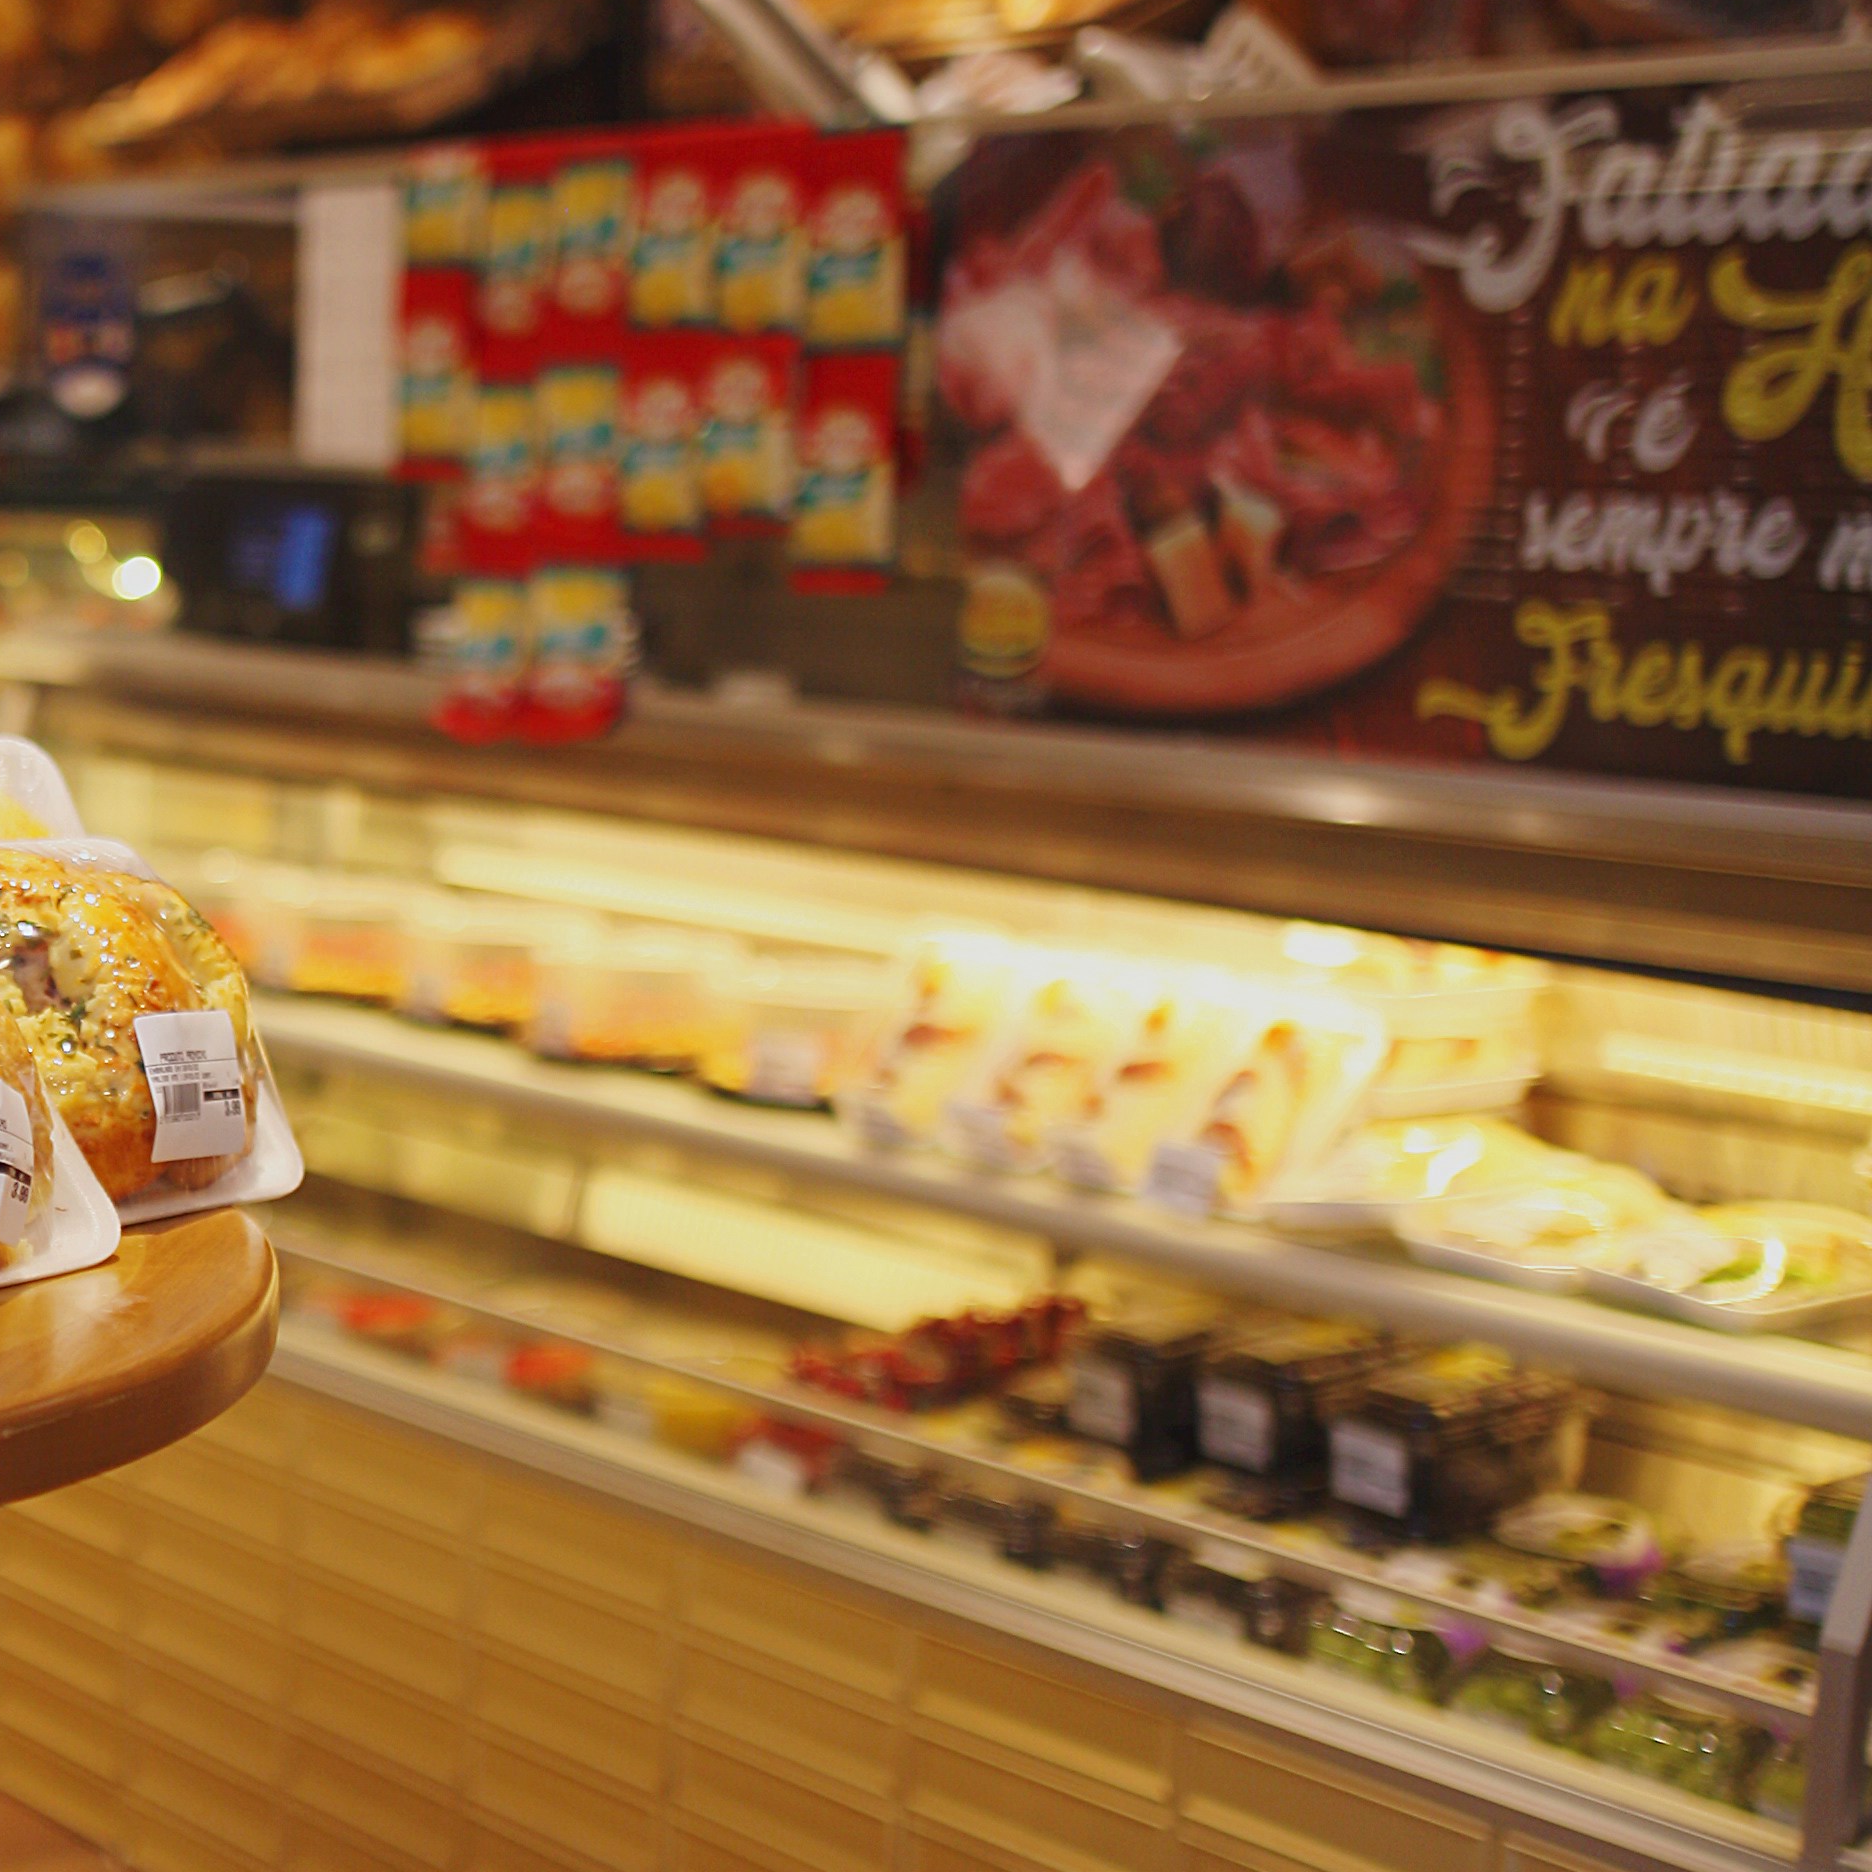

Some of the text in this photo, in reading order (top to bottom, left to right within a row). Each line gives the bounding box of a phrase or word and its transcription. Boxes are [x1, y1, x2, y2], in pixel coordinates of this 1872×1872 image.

[1550, 251, 1696, 347] na
[1521, 486, 1808, 596] sempre
[1417, 598, 1872, 764] Fresqui
